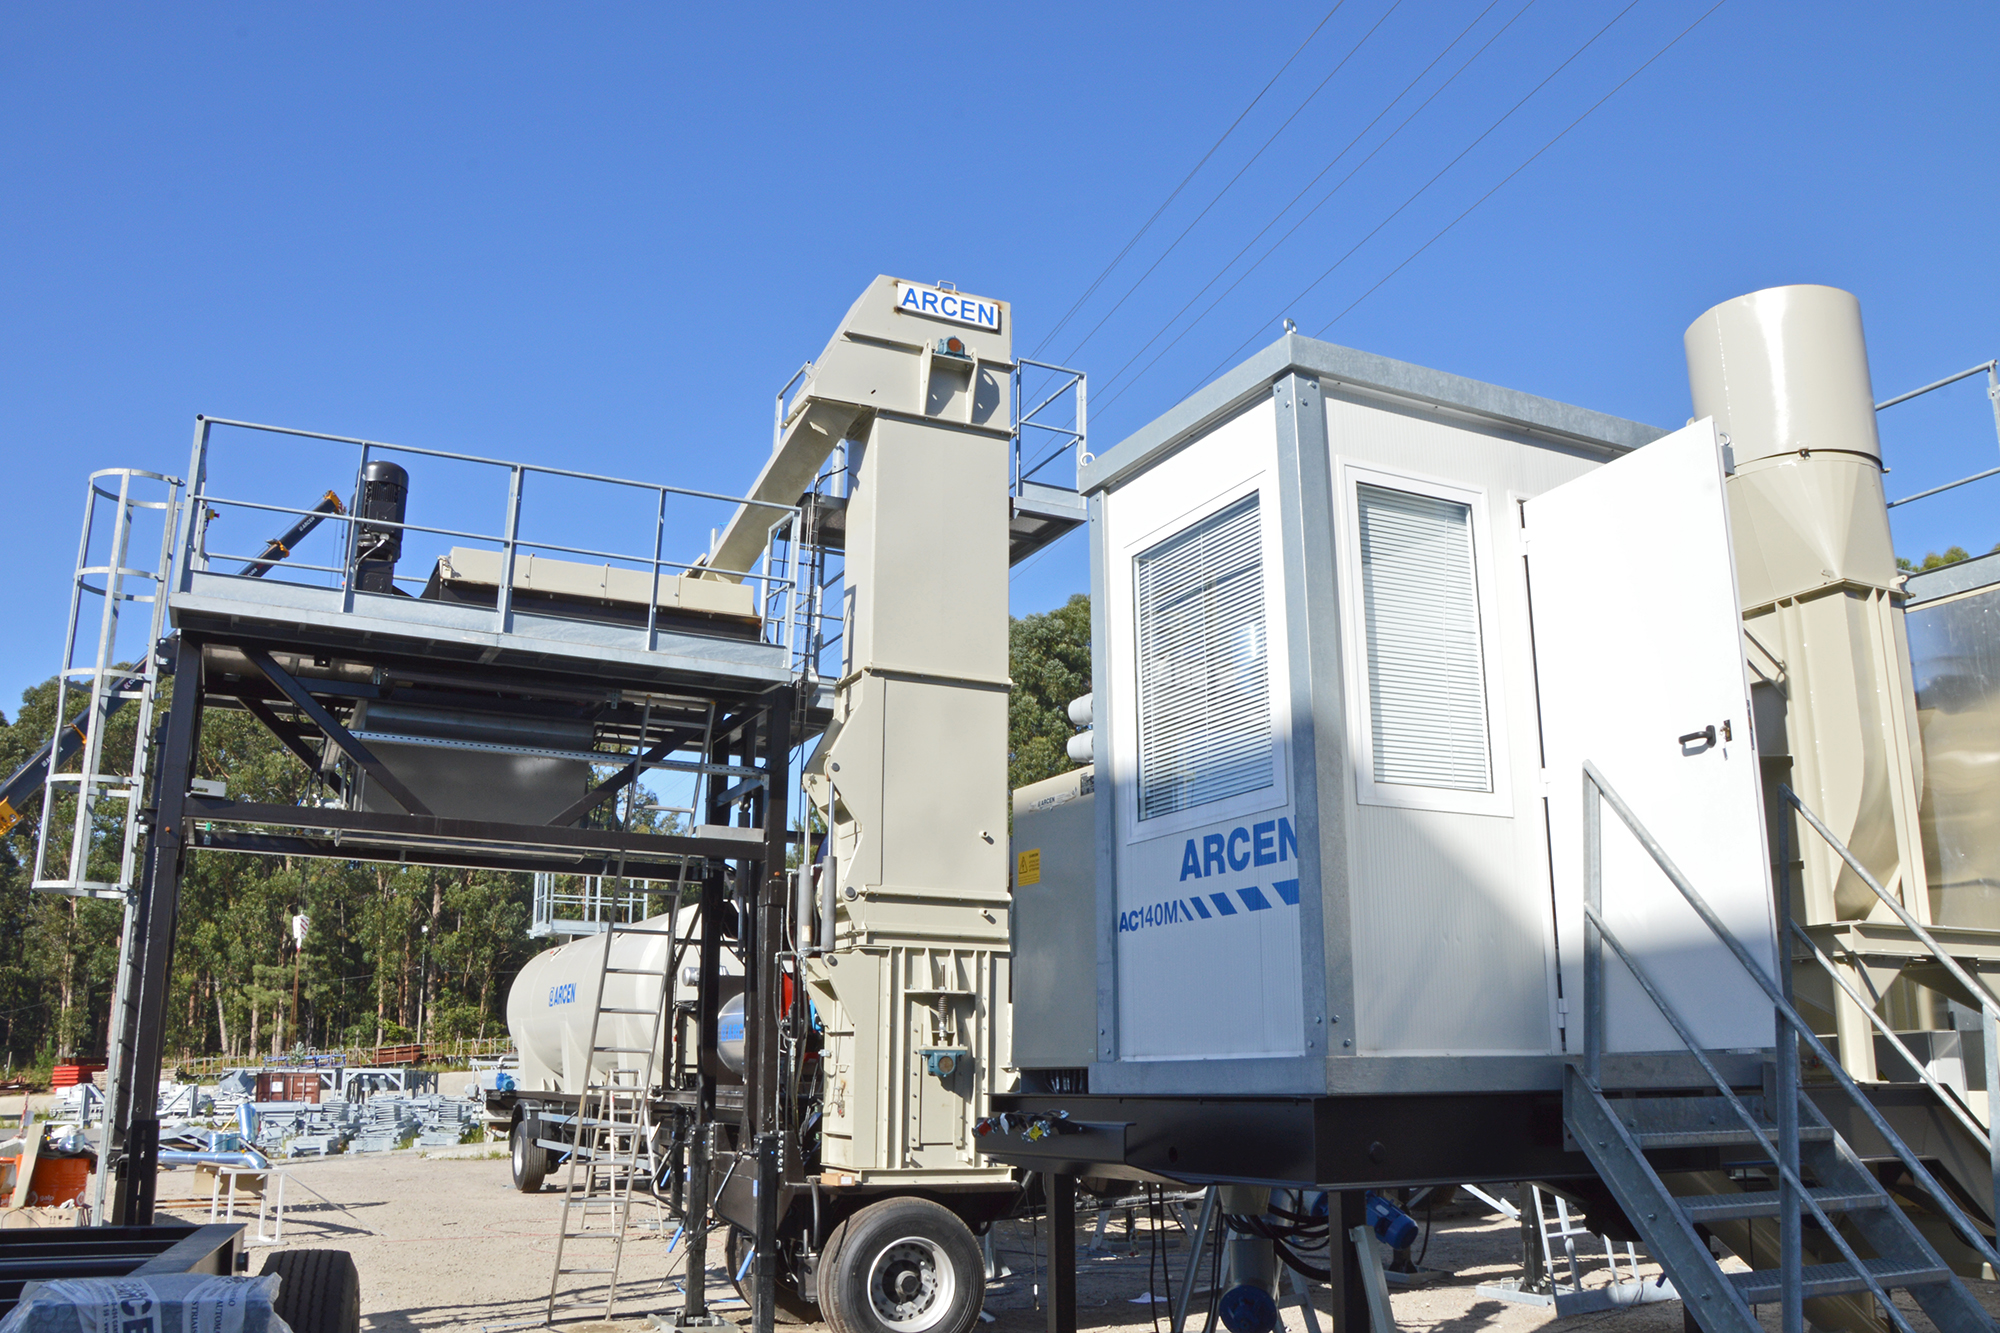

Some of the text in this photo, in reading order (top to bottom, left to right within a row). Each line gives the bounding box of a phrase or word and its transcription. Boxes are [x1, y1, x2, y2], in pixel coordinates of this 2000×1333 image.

[902, 288, 994, 326] ARCEN
[1179, 815, 1298, 882] ARCEN
[1118, 900, 1178, 933] AC140M
[554, 982, 577, 1006] ARCEN
